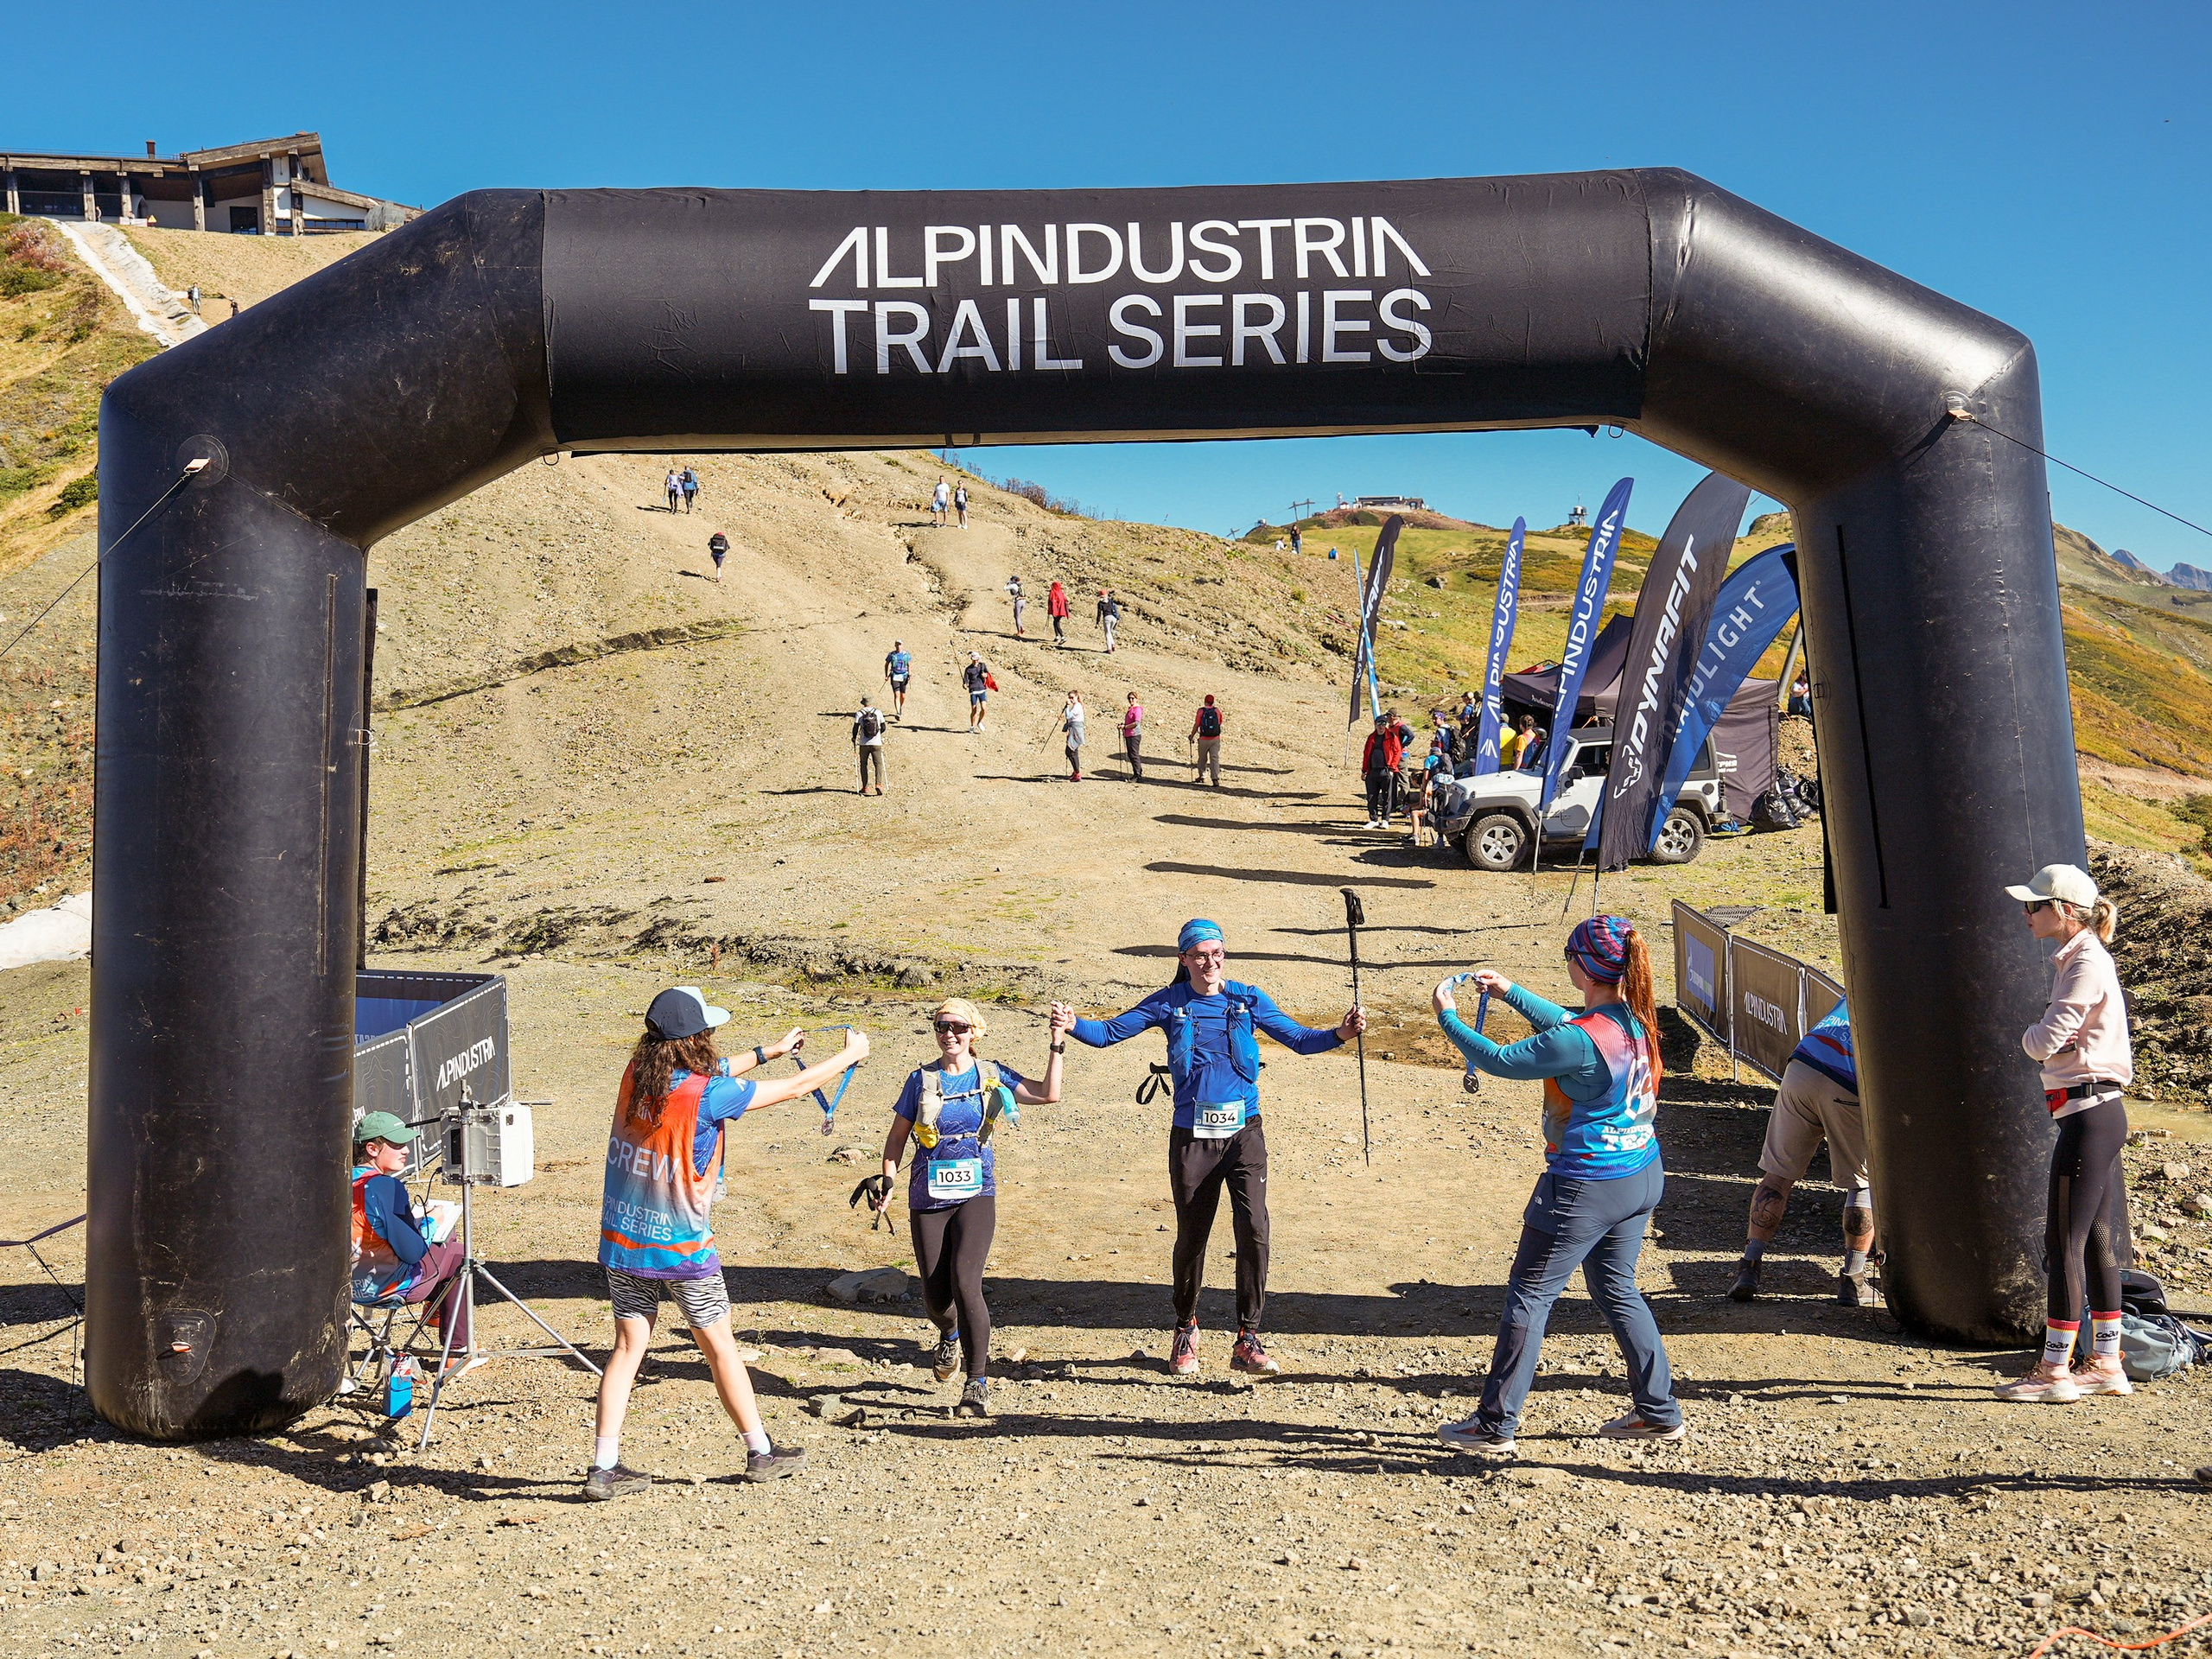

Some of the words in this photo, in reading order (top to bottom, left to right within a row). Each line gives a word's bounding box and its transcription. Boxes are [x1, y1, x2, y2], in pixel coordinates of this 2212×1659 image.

[809, 216, 1432, 289] ALPINDUSTRIA
[809, 297, 1084, 374] TRAIL
[1107, 288, 1433, 369] SERIES
[1630, 533, 1698, 755] DYNAFIT
[1744, 990, 1788, 1036] ALPINDUSTRIA
[436, 1035, 496, 1092] ALPINDUSTRIA
[1205, 1112, 1236, 1124] 1034
[607, 1136, 680, 1184] CREW
[938, 1170, 971, 1183] 1033
[620, 1217, 672, 1242] SERIES
